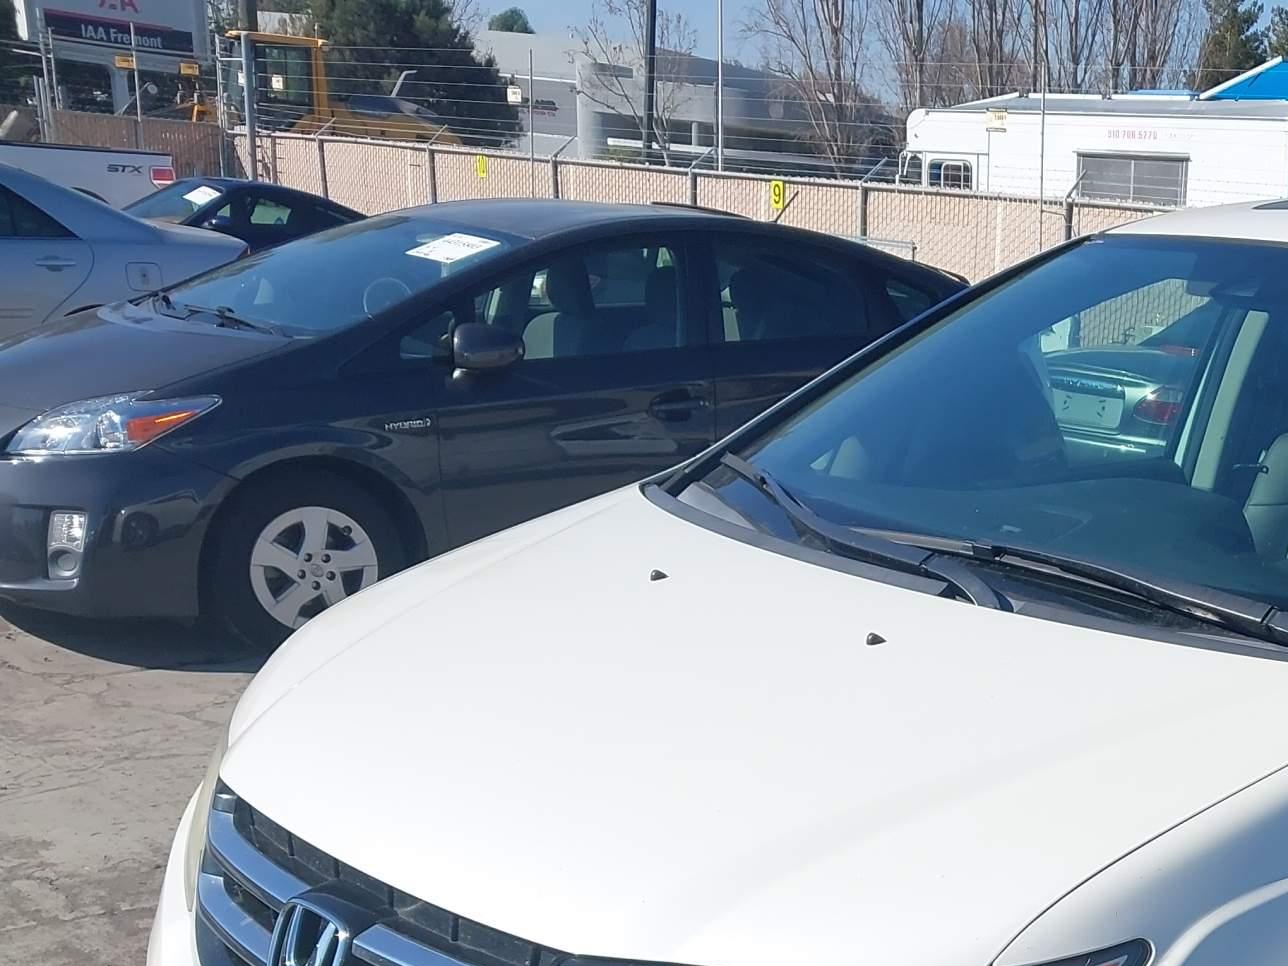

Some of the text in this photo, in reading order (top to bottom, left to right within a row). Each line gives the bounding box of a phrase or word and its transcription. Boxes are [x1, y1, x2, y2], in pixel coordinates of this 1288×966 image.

[81, 23, 163, 48] IAA Fremont
[106, 164, 144, 174] STX
[773, 183, 781, 204] 9
